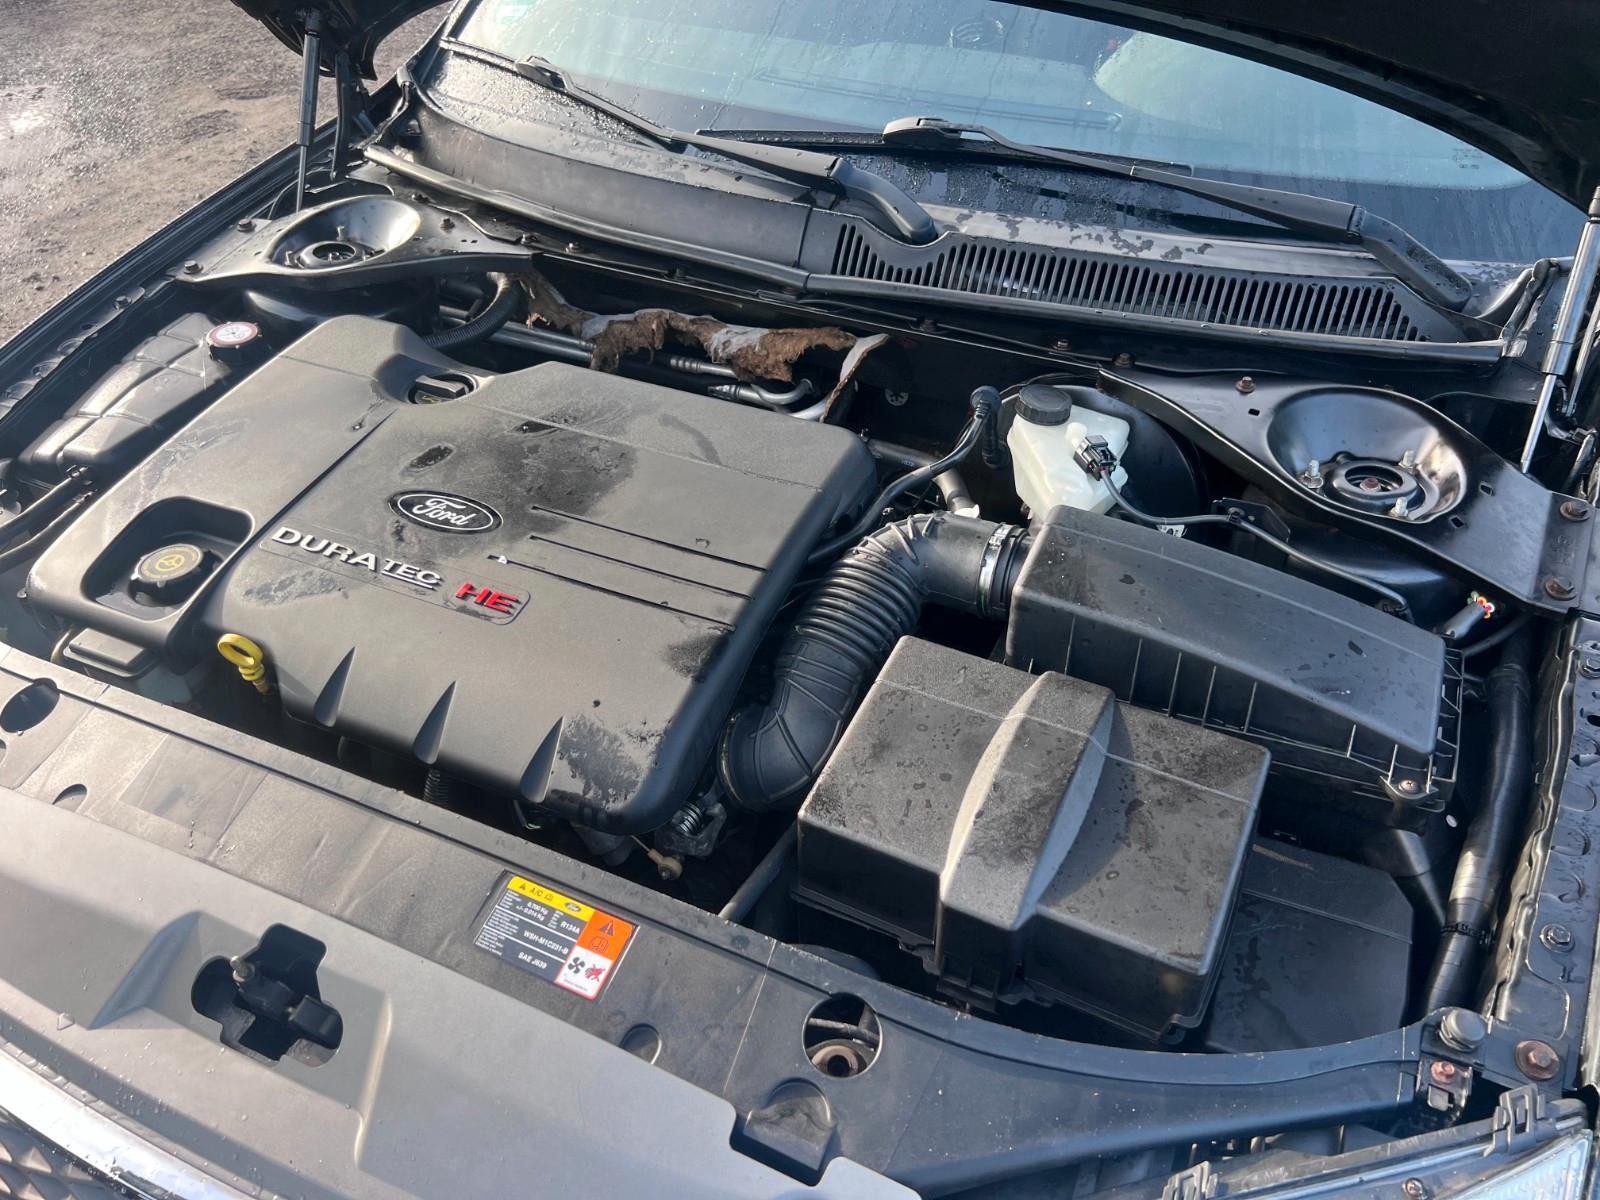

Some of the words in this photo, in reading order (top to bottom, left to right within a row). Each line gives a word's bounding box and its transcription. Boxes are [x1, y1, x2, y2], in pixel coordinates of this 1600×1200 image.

[412, 498, 476, 527] Ford
[455, 583, 519, 614] HE
[529, 887, 544, 898] A/C
[560, 921, 580, 934] R134A
[518, 952, 532, 963] SAE
